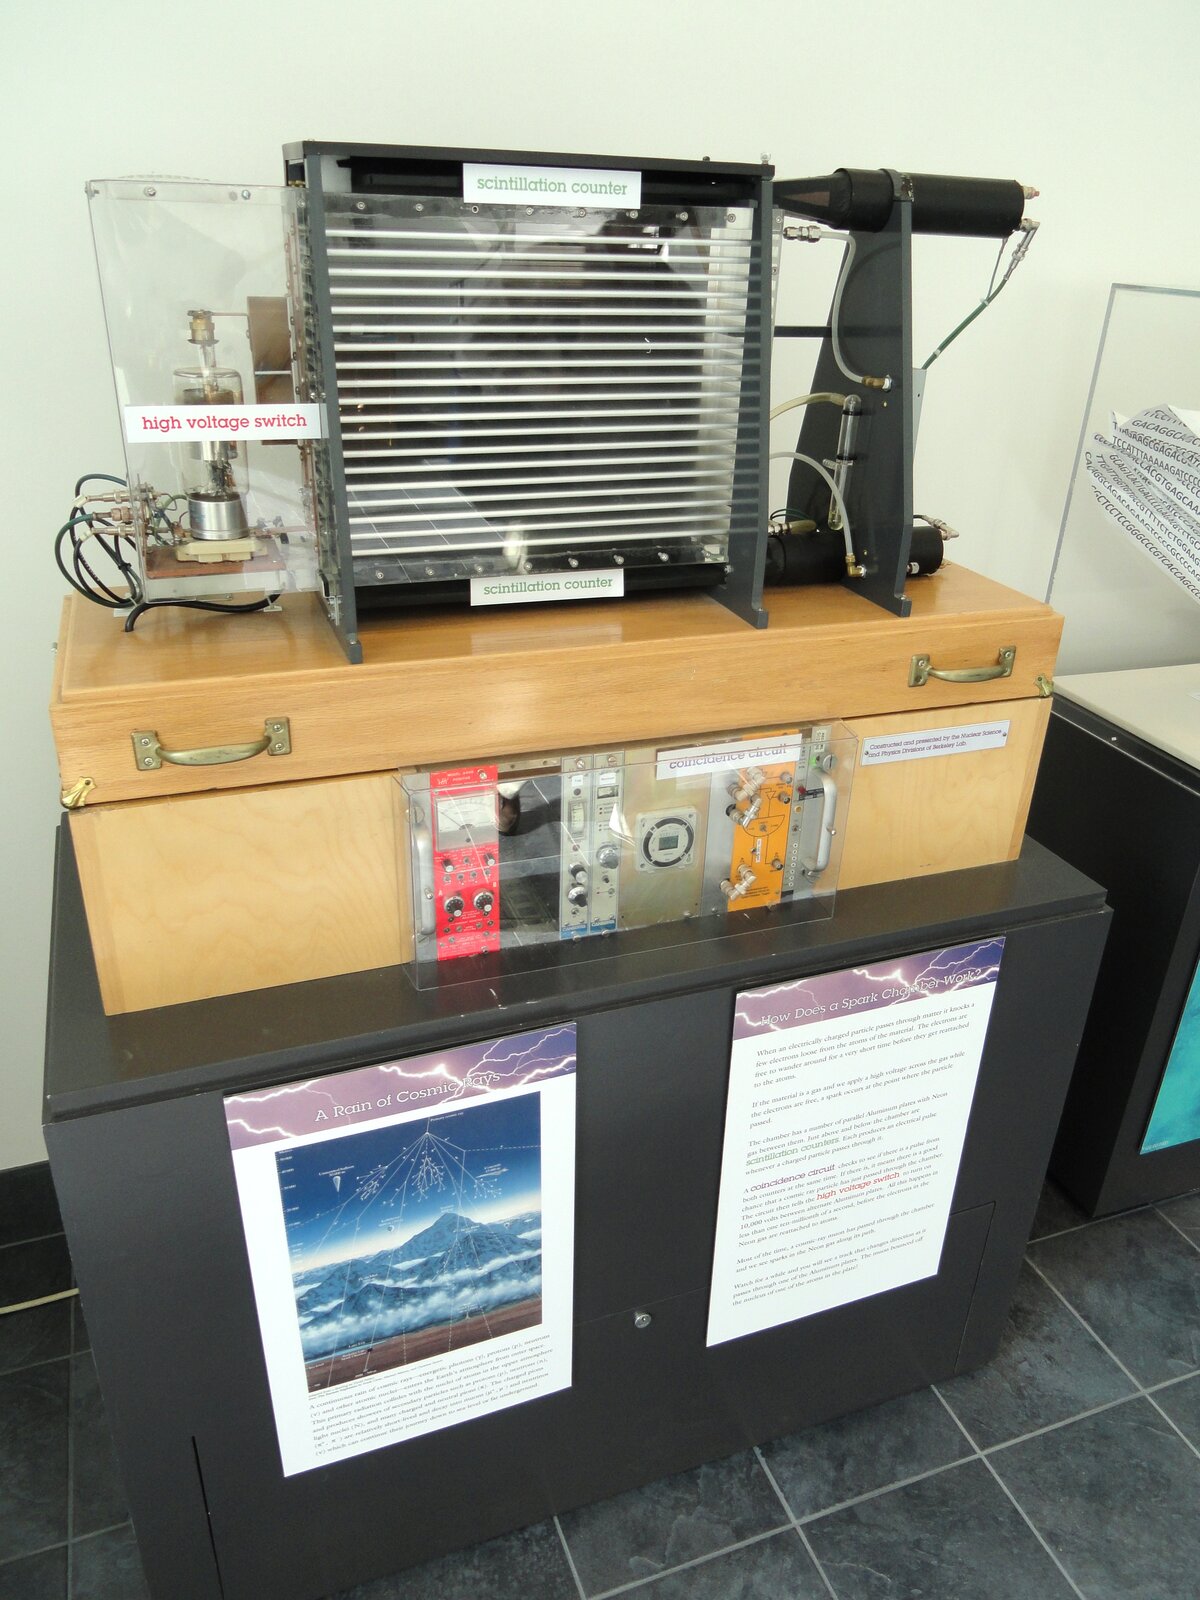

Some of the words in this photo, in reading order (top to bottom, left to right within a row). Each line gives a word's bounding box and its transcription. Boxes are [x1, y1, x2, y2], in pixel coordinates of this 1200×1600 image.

[477, 176, 567, 192] scintillation
[572, 181, 627, 195] counter
[142, 417, 181, 432] high
[187, 415, 250, 432] voltage
[255, 414, 307, 427] switch
[484, 580, 560, 595] scintillation
[564, 578, 613, 590] counter
[870, 739, 902, 750] Constructed
[904, 738, 915, 746] and
[916, 736, 942, 745] presented
[943, 734, 950, 743] by
[961, 731, 981, 740] Nuclear
[983, 729, 1002, 737] Science
[881, 749, 901, 758] Physics
[902, 746, 925, 754] Divisions
[932, 742, 955, 751] Berkeley
[760, 1012, 790, 1026] How
[795, 1004, 826, 1019] Does
[829, 1001, 839, 1011] a
[841, 993, 878, 1011] Spark
[944, 969, 981, 985] Work?
[756, 1048, 776, 1056] When
[788, 1038, 821, 1049] electrically
[824, 1030, 849, 1041] charged
[850, 1025, 873, 1037] particle
[875, 1021, 894, 1031] passes
[895, 1014, 920, 1025] through
[922, 1010, 942, 1018] matter
[949, 1003, 969, 1012] knocks
[769, 1054, 798, 1064] electrons
[848, 1038, 867, 1046] atoms
[930, 1016, 956, 1026] electrons
[778, 1062, 801, 1071] wander
[804, 1055, 826, 1066] around
[892, 1037, 911, 1045] before
[927, 1030, 937, 1038] get
[938, 1021, 969, 1033] reattached
[315, 1109, 328, 1122] A
[333, 1101, 372, 1119] Rain
[377, 1095, 392, 1108] of
[397, 1081, 456, 1104] Cosmic
[463, 1071, 500, 1089] Rays
[749, 1172, 806, 1191] coincidence
[807, 1163, 835, 1176] circuit
[816, 1189, 836, 1200] high
[839, 1180, 871, 1193] voltage
[872, 1171, 899, 1184] switch
